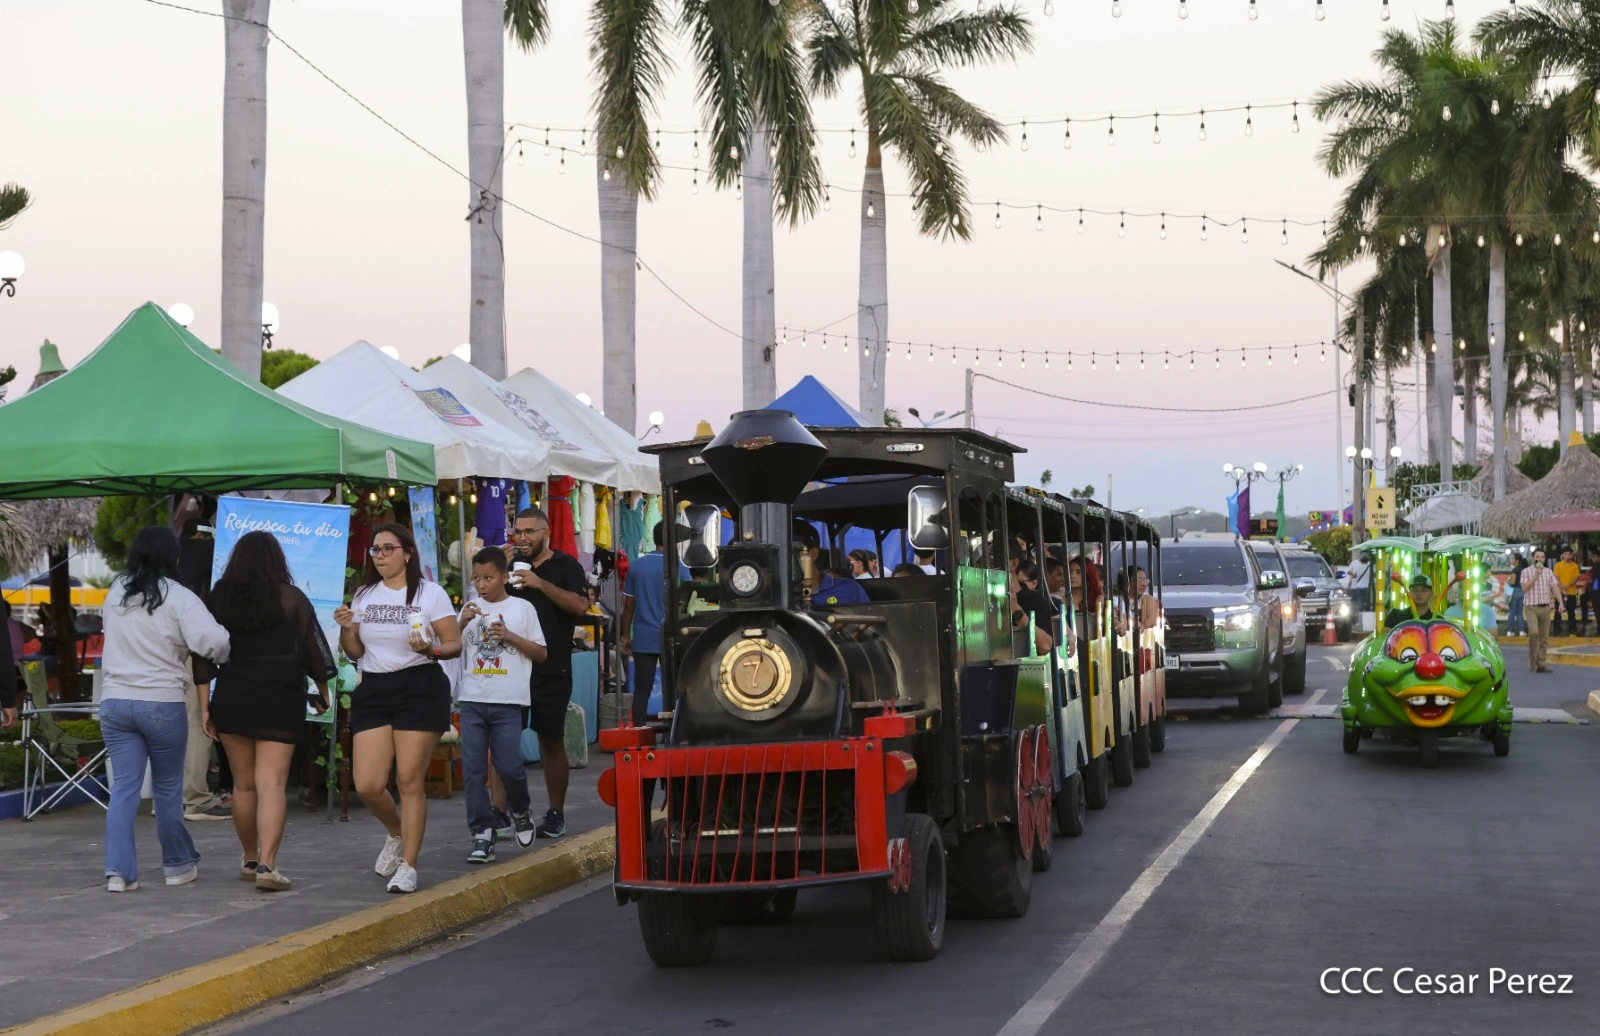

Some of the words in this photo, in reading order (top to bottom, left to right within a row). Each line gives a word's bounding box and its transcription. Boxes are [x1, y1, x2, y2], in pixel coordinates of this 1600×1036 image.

[491, 485, 500, 498] 10
[224, 512, 291, 540] Refresca
[292, 520, 313, 536] tu
[743, 660, 761, 688] 7
